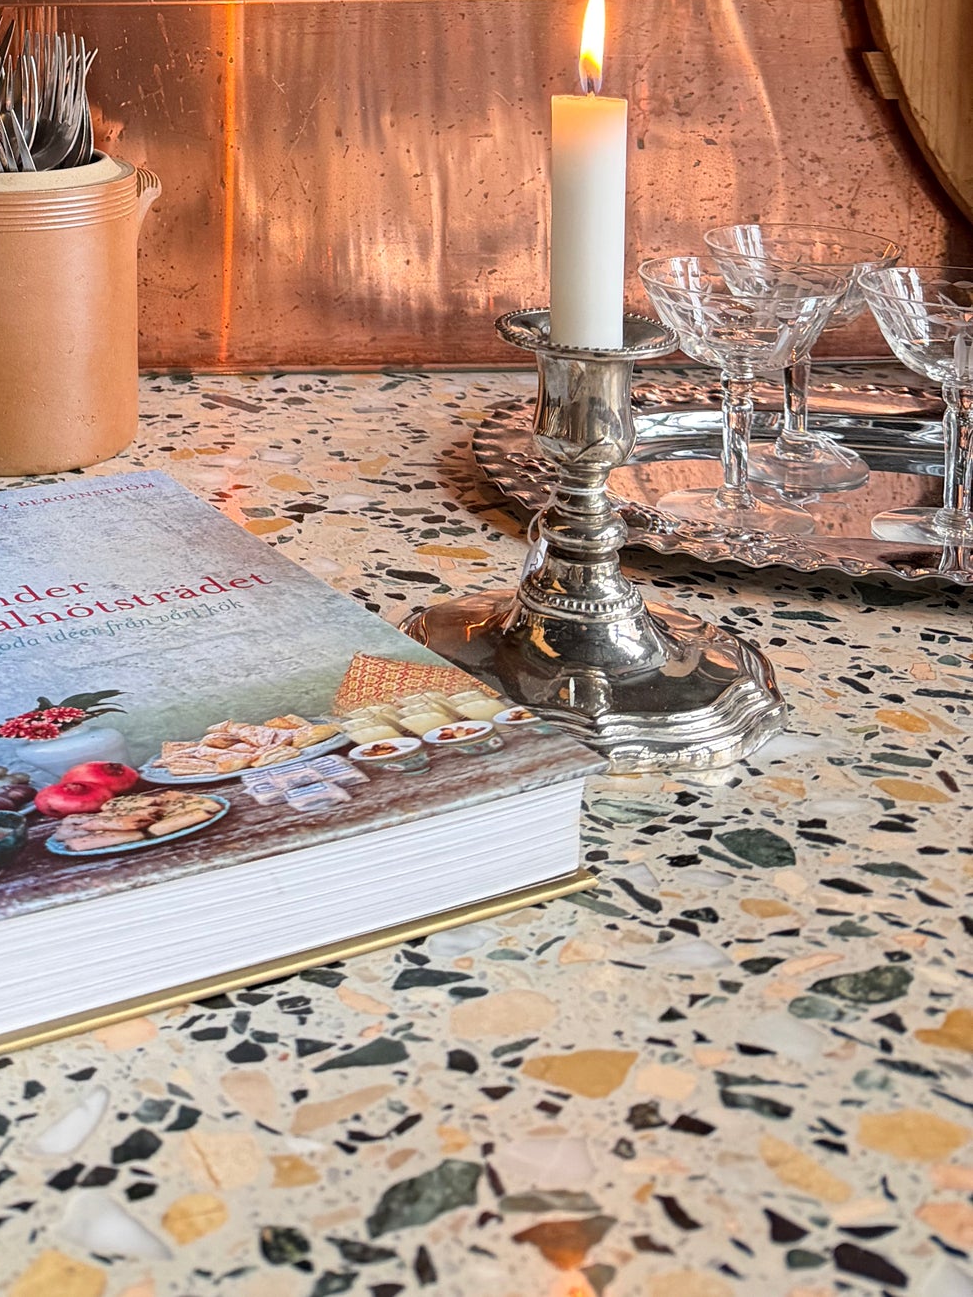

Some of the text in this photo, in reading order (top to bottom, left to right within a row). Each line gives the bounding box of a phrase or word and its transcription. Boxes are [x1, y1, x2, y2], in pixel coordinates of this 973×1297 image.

[18, 482, 156, 507] BERGENSTRÖM
[103, 615, 151, 638] från
[156, 606, 199, 624] vårt
[199, 597, 245, 619] kök
